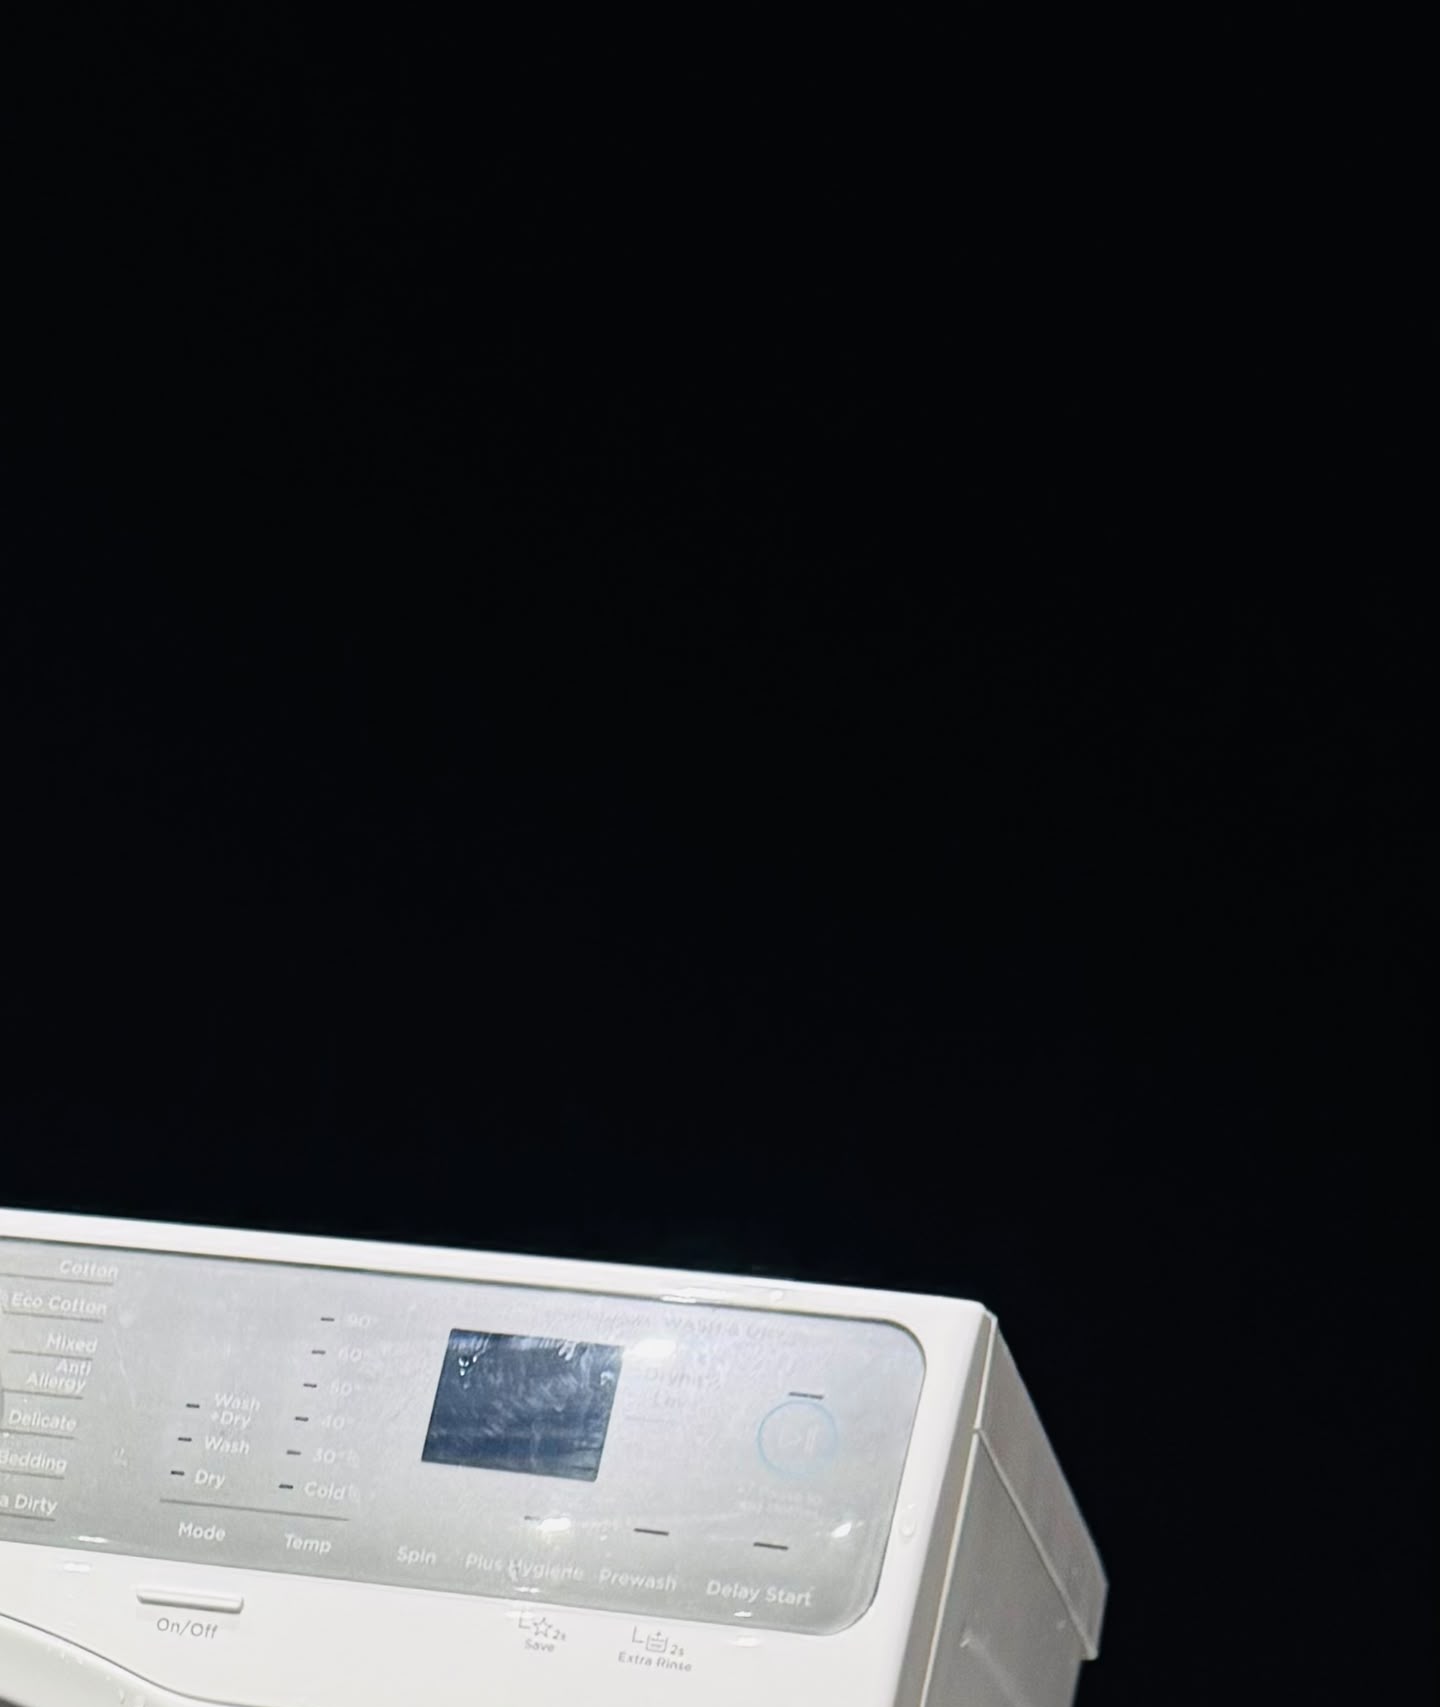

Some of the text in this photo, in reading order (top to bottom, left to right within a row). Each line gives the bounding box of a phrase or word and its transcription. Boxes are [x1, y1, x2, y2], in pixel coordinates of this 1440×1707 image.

[60, 1259, 119, 1279] Cotton
[11, 1292, 107, 1315] Eco Cotton
[46, 1332, 98, 1354] Mixed
[56, 1360, 91, 1376] Anti
[26, 1372, 86, 1394] Allergy
[215, 1392, 261, 1411] Wash
[9, 1409, 78, 1431] Delicate
[205, 1435, 250, 1455] Wash
[195, 1469, 225, 1489] Dry
[303, 1481, 346, 1500] Cold
[15, 1493, 58, 1516] Dirty
[178, 1521, 226, 1542] Mode
[283, 1533, 332, 1554] Temp
[397, 1545, 436, 1565] Spin
[465, 1552, 503, 1574] Plus
[598, 1567, 677, 1593] Prewash
[706, 1579, 812, 1608] Delay Start
[157, 1617, 219, 1640] On/Off
[524, 1638, 556, 1652] Save
[618, 1651, 693, 1673] Extra Rinse
